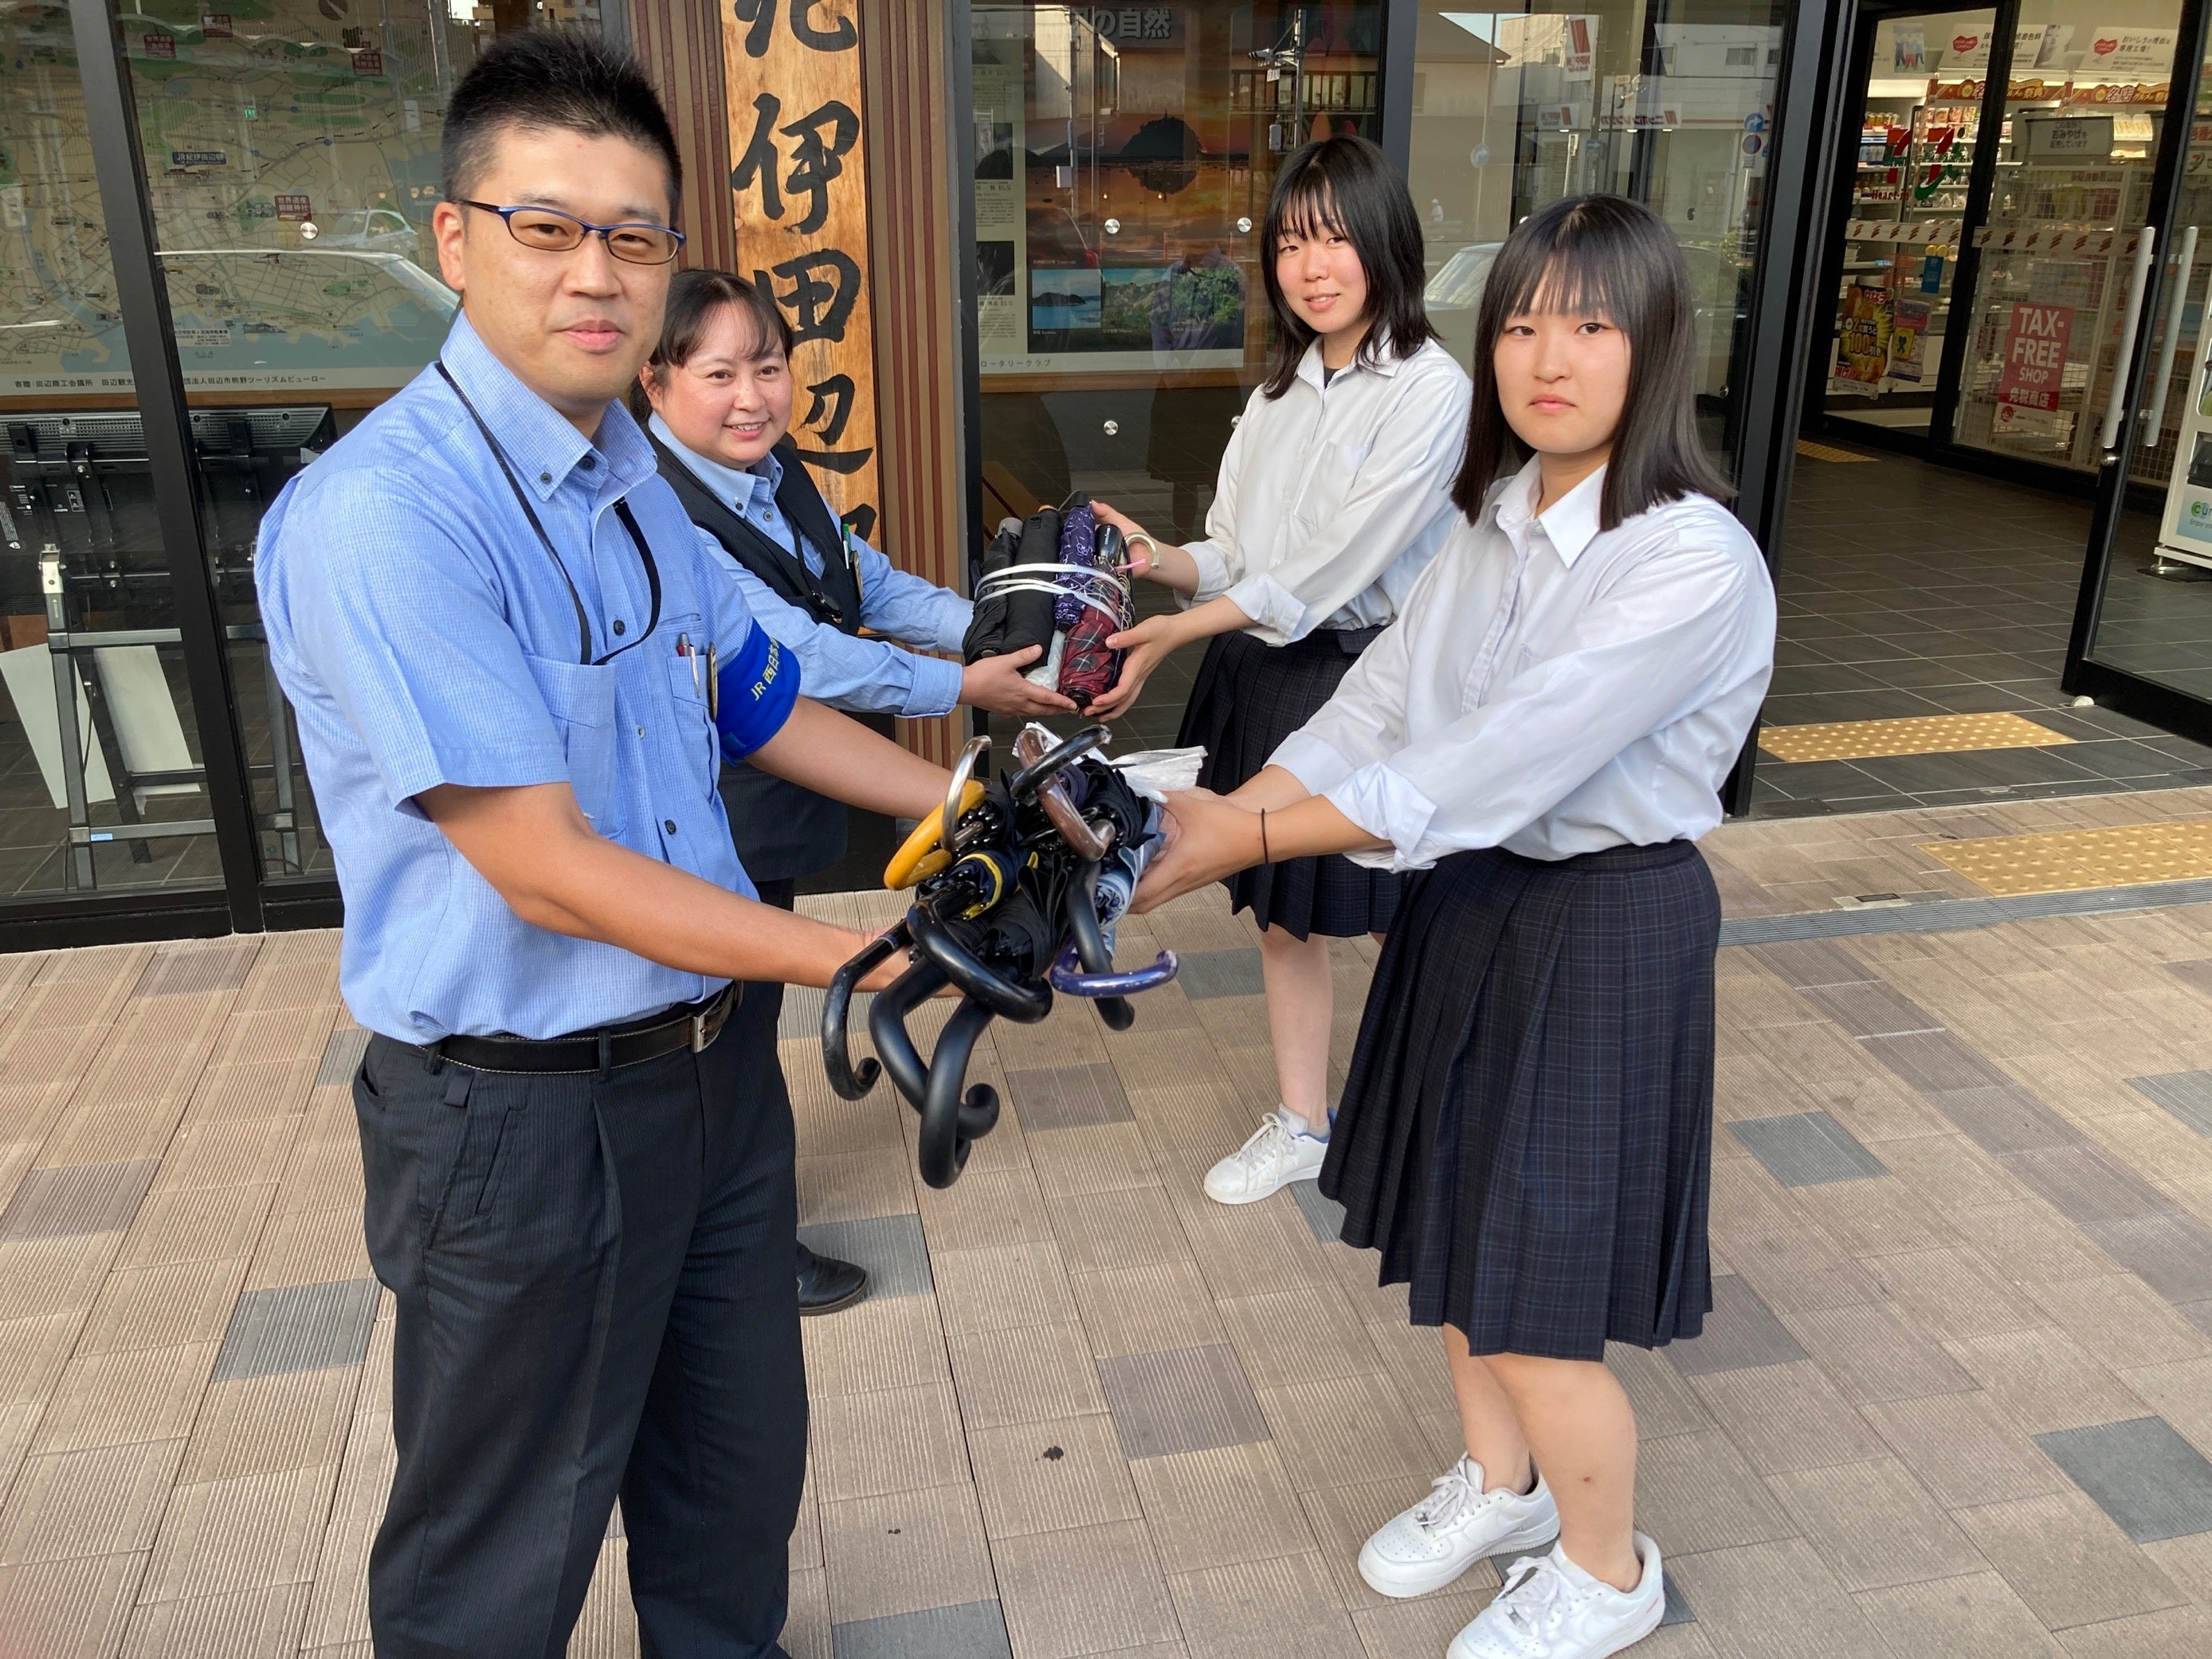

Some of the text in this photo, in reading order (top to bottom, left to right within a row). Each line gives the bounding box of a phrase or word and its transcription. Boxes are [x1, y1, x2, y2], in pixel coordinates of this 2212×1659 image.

[732, 0, 877, 550] 伊田辺
[2019, 307, 2065, 338] TAX-
[980, 359, 1051, 368] ロータリークラブ
[2011, 337, 2062, 369] FREE
[2018, 367, 2049, 384] SHOP
